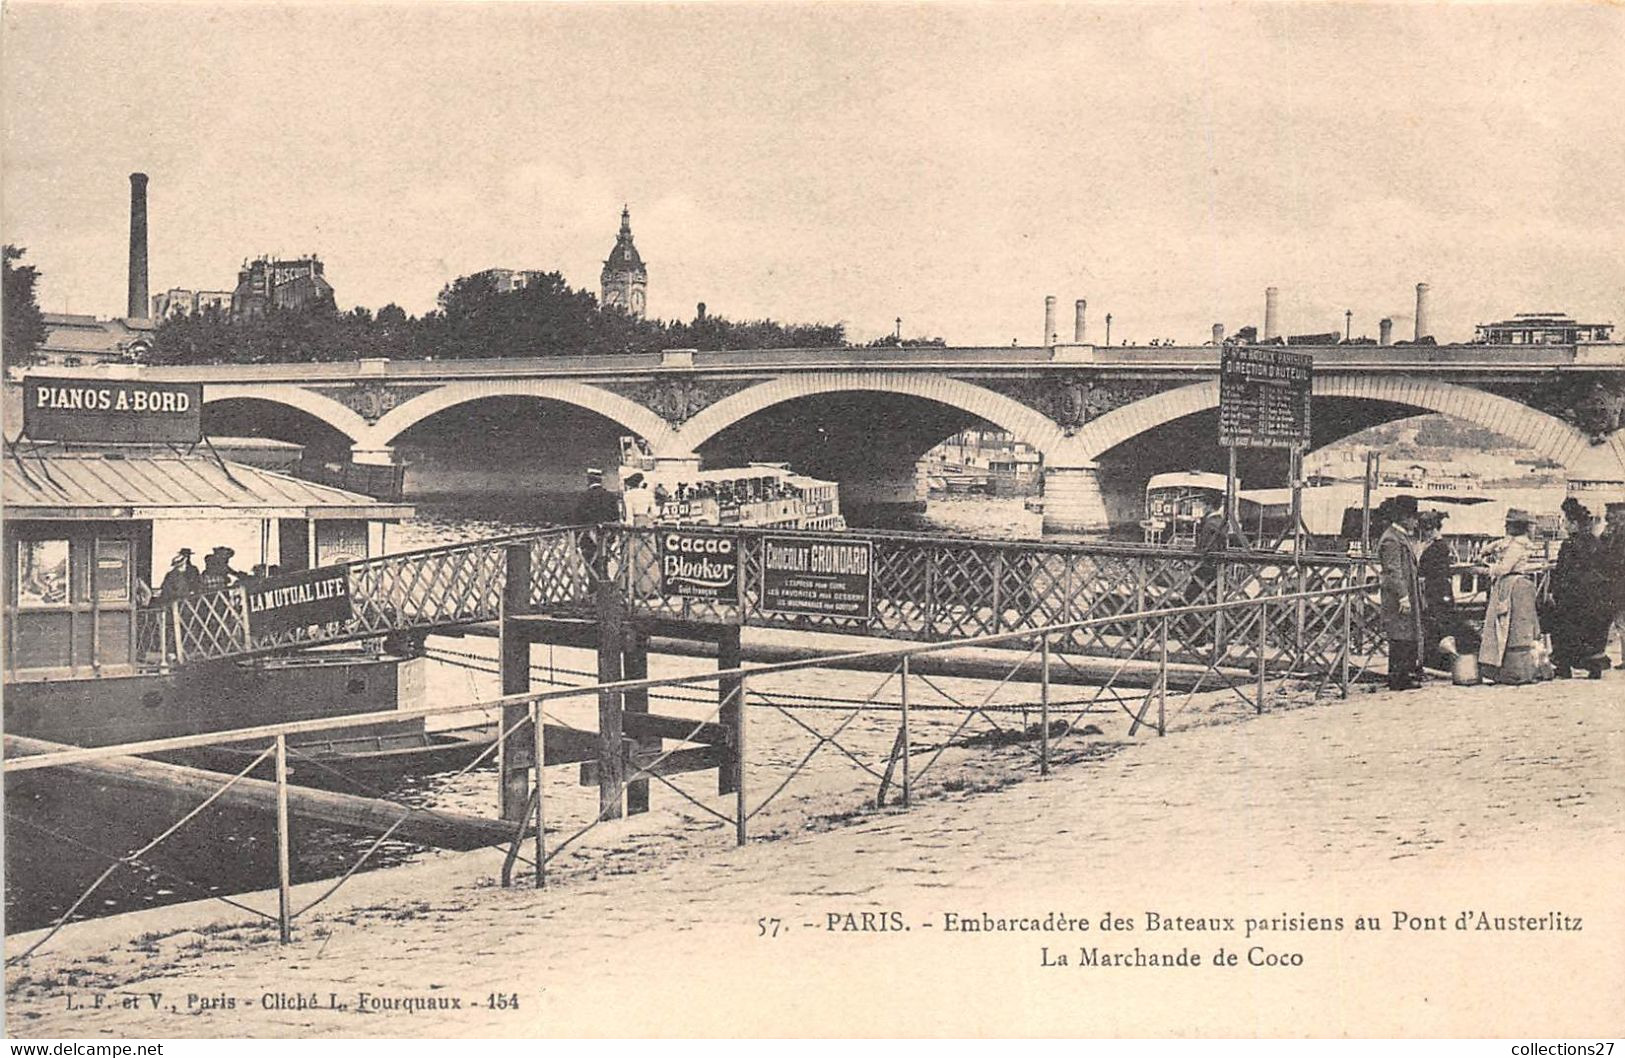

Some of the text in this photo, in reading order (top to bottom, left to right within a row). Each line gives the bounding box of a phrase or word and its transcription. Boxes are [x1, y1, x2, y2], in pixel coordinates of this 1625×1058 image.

[1226, 361, 1267, 375] DIRECTION
[37, 387, 111, 409] PIANOS
[665, 534, 732, 554] Cacao
[664, 555, 735, 579] Blooker
[766, 542, 868, 576] CHOCOLAT GRONDARD
[250, 577, 345, 612] LA MUTUAL LIFE
